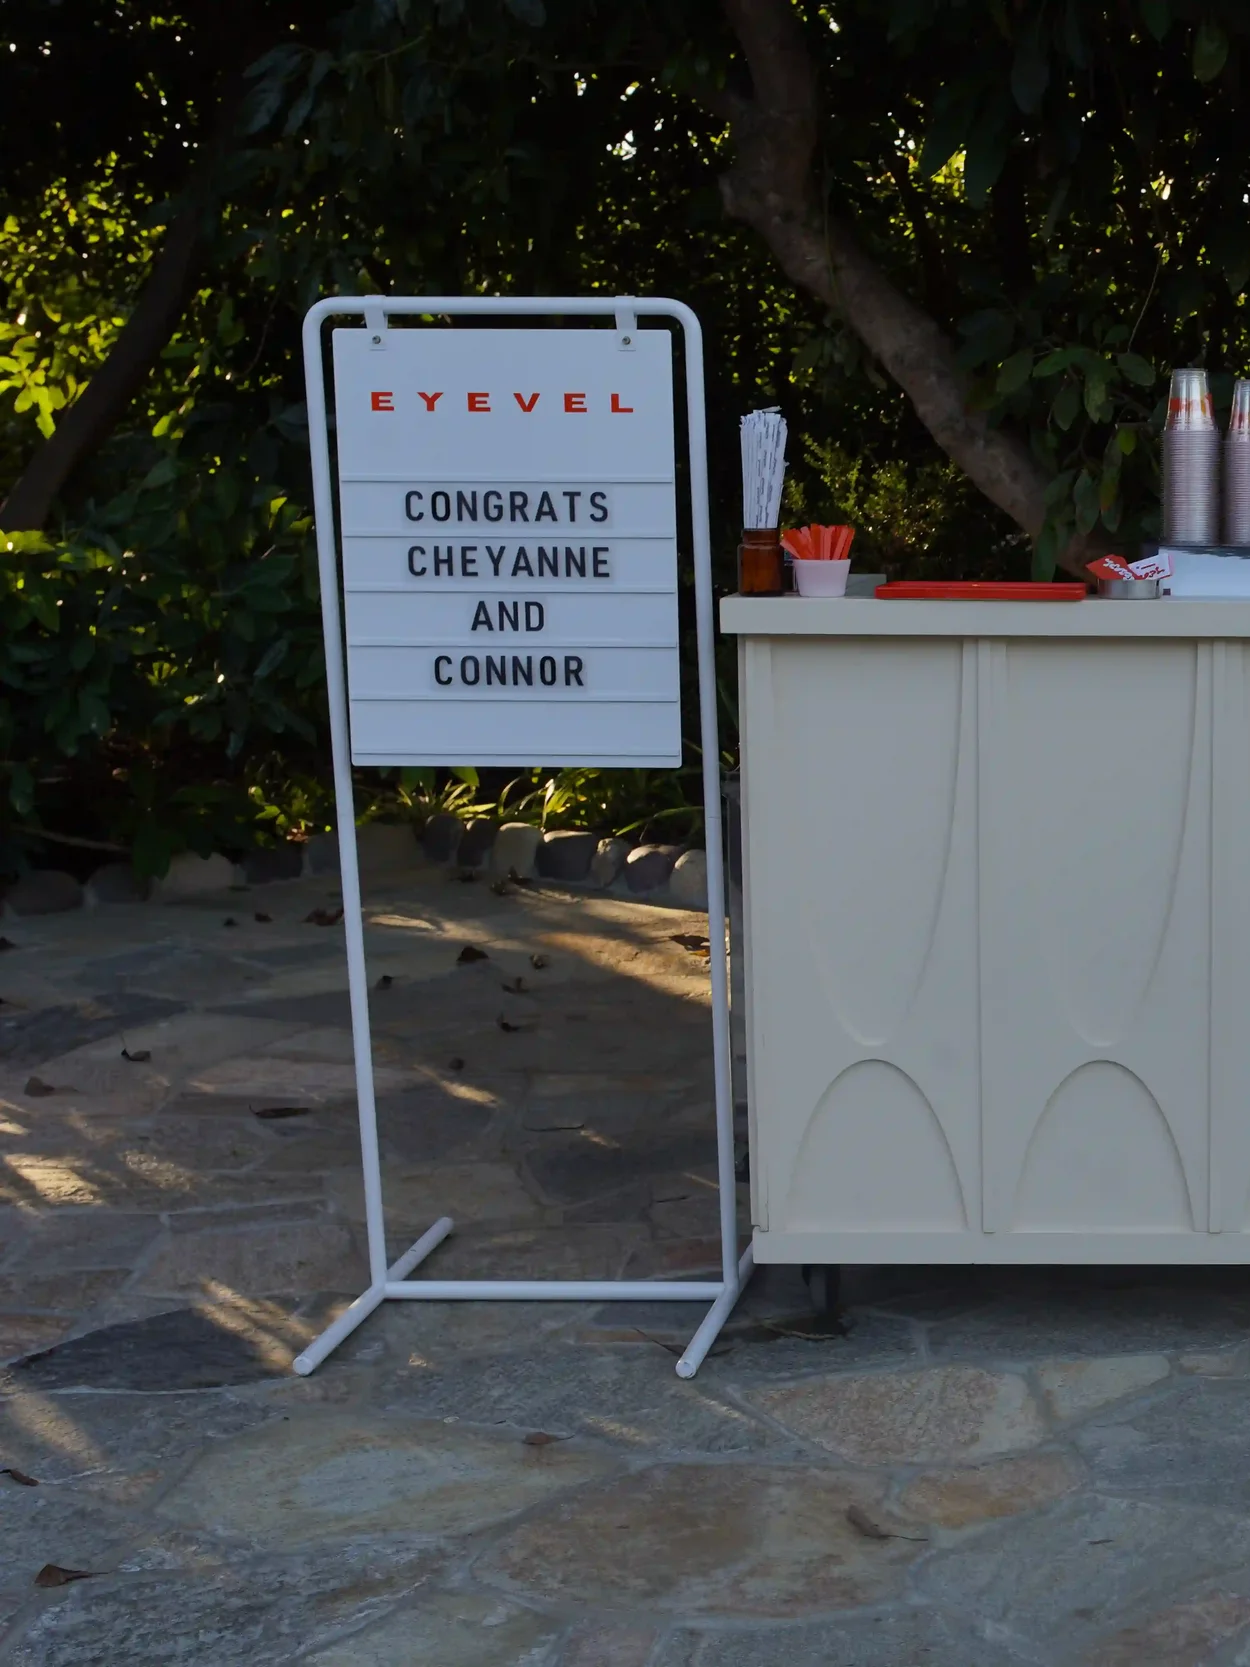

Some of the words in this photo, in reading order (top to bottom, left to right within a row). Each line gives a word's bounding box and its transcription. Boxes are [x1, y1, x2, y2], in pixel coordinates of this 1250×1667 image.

[371, 391, 634, 413] EYEVEL
[405, 490, 609, 523] CONGRATS
[407, 545, 611, 578] CHEYANNE
[470, 600, 545, 632] AND
[434, 655, 585, 687] CONNOR
